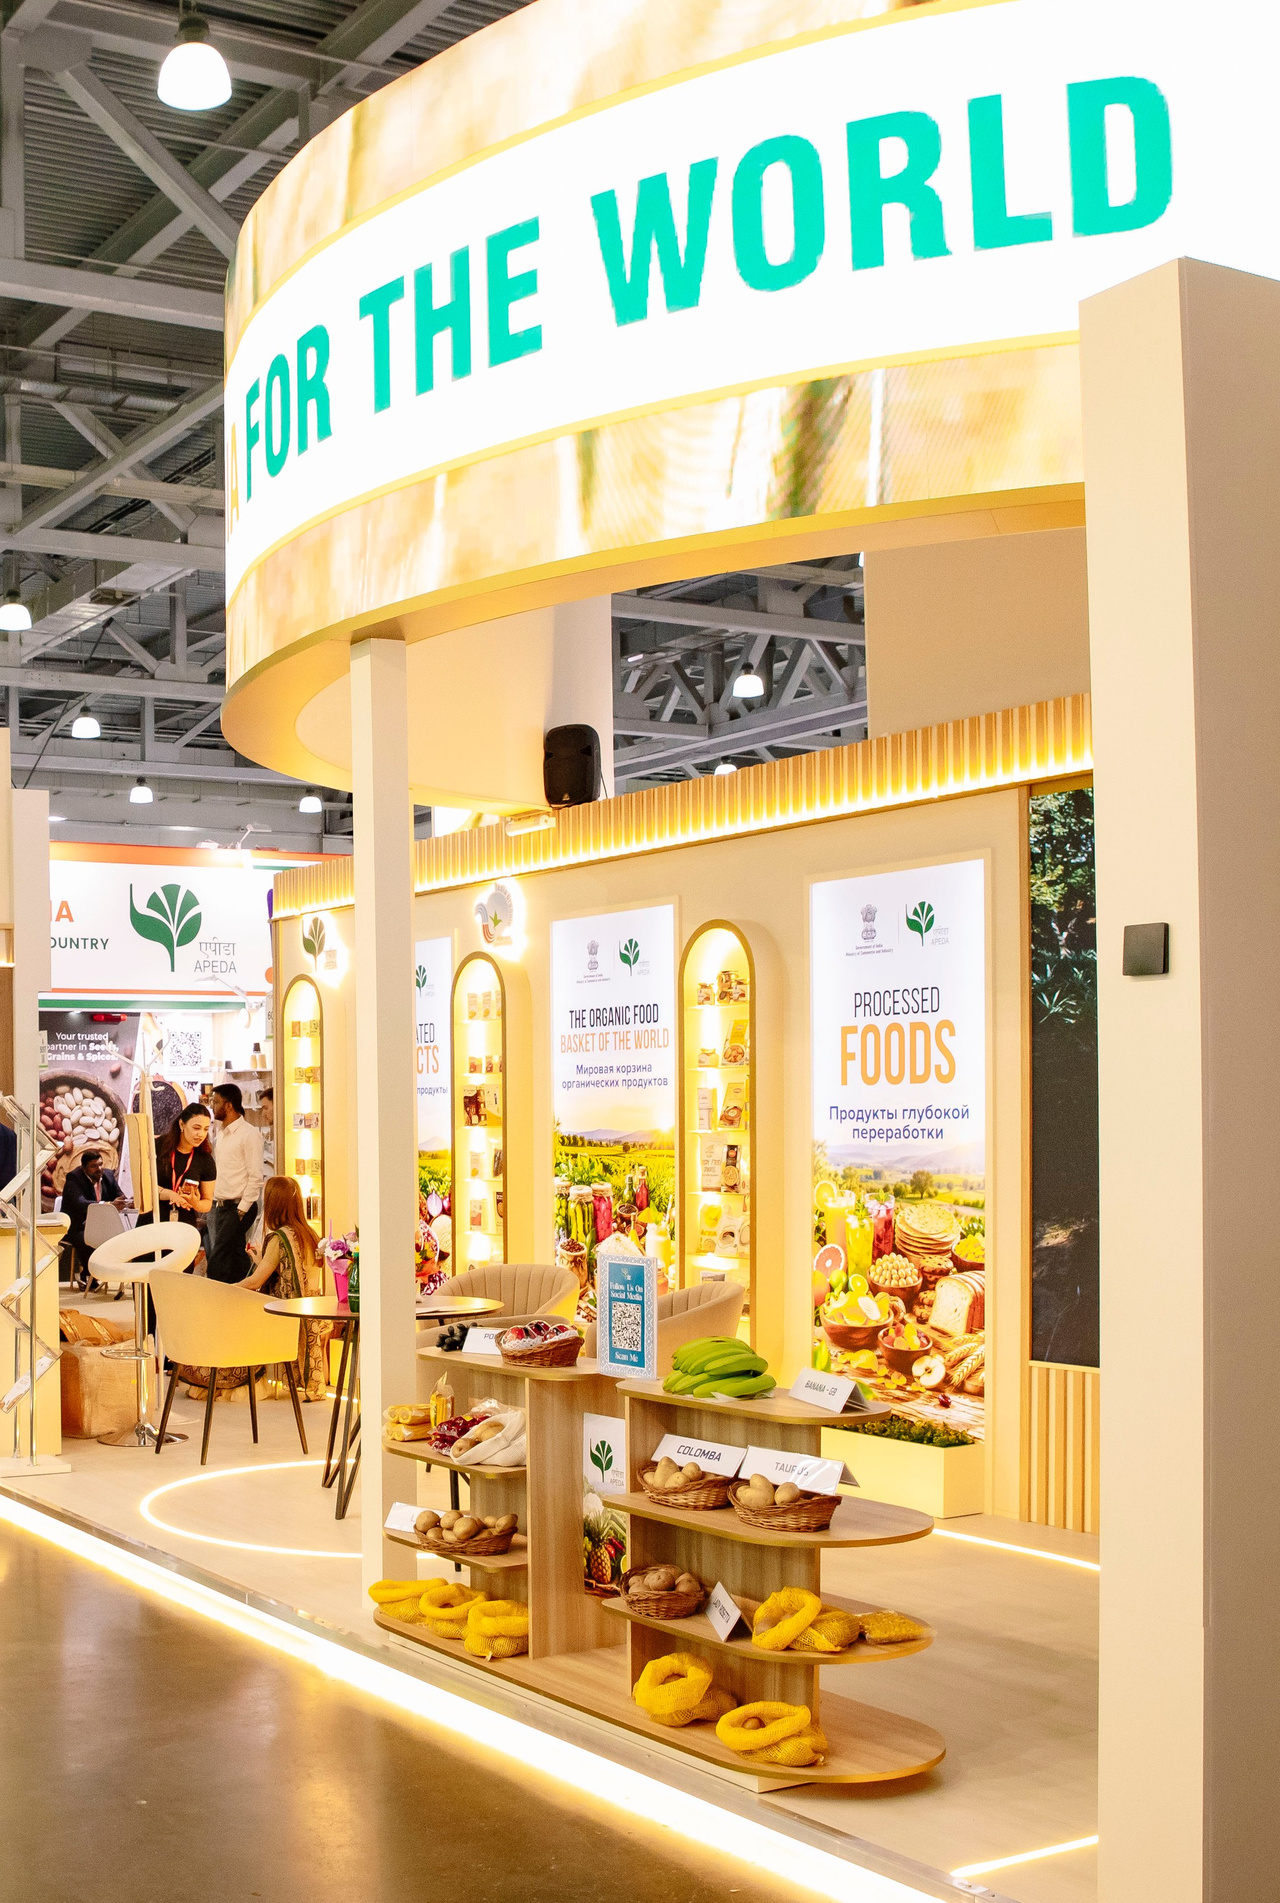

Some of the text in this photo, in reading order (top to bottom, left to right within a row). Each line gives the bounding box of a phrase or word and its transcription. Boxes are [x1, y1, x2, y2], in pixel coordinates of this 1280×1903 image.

[244, 323, 332, 501] FOR
[360, 217, 542, 413] THE
[591, 76, 1173, 327] WORLD
[194, 960, 237, 973] APEDA
[854, 986, 940, 1018] PROCESSED
[569, 1003, 659, 1029] THE ORGANIC FOOD
[55, 1032, 108, 1040] Your trusted
[560, 1028, 669, 1054] BASKET OF THE WORLD
[79, 1042, 87, 1050] in
[841, 1019, 956, 1086] FOODS
[576, 1063, 652, 1077] Мировая корзина
[562, 1077, 668, 1091] органических продуктов
[829, 1104, 970, 1124] Продукты глубокой
[852, 1125, 944, 1143] переработки
[609, 1282, 625, 1290] Follow
[635, 1285, 643, 1293] On
[610, 1290, 642, 1301] Social Media
[615, 1351, 638, 1363] Scan Me
[804, 1380, 826, 1393] BANANA
[677, 1444, 722, 1462] COLOMBA
